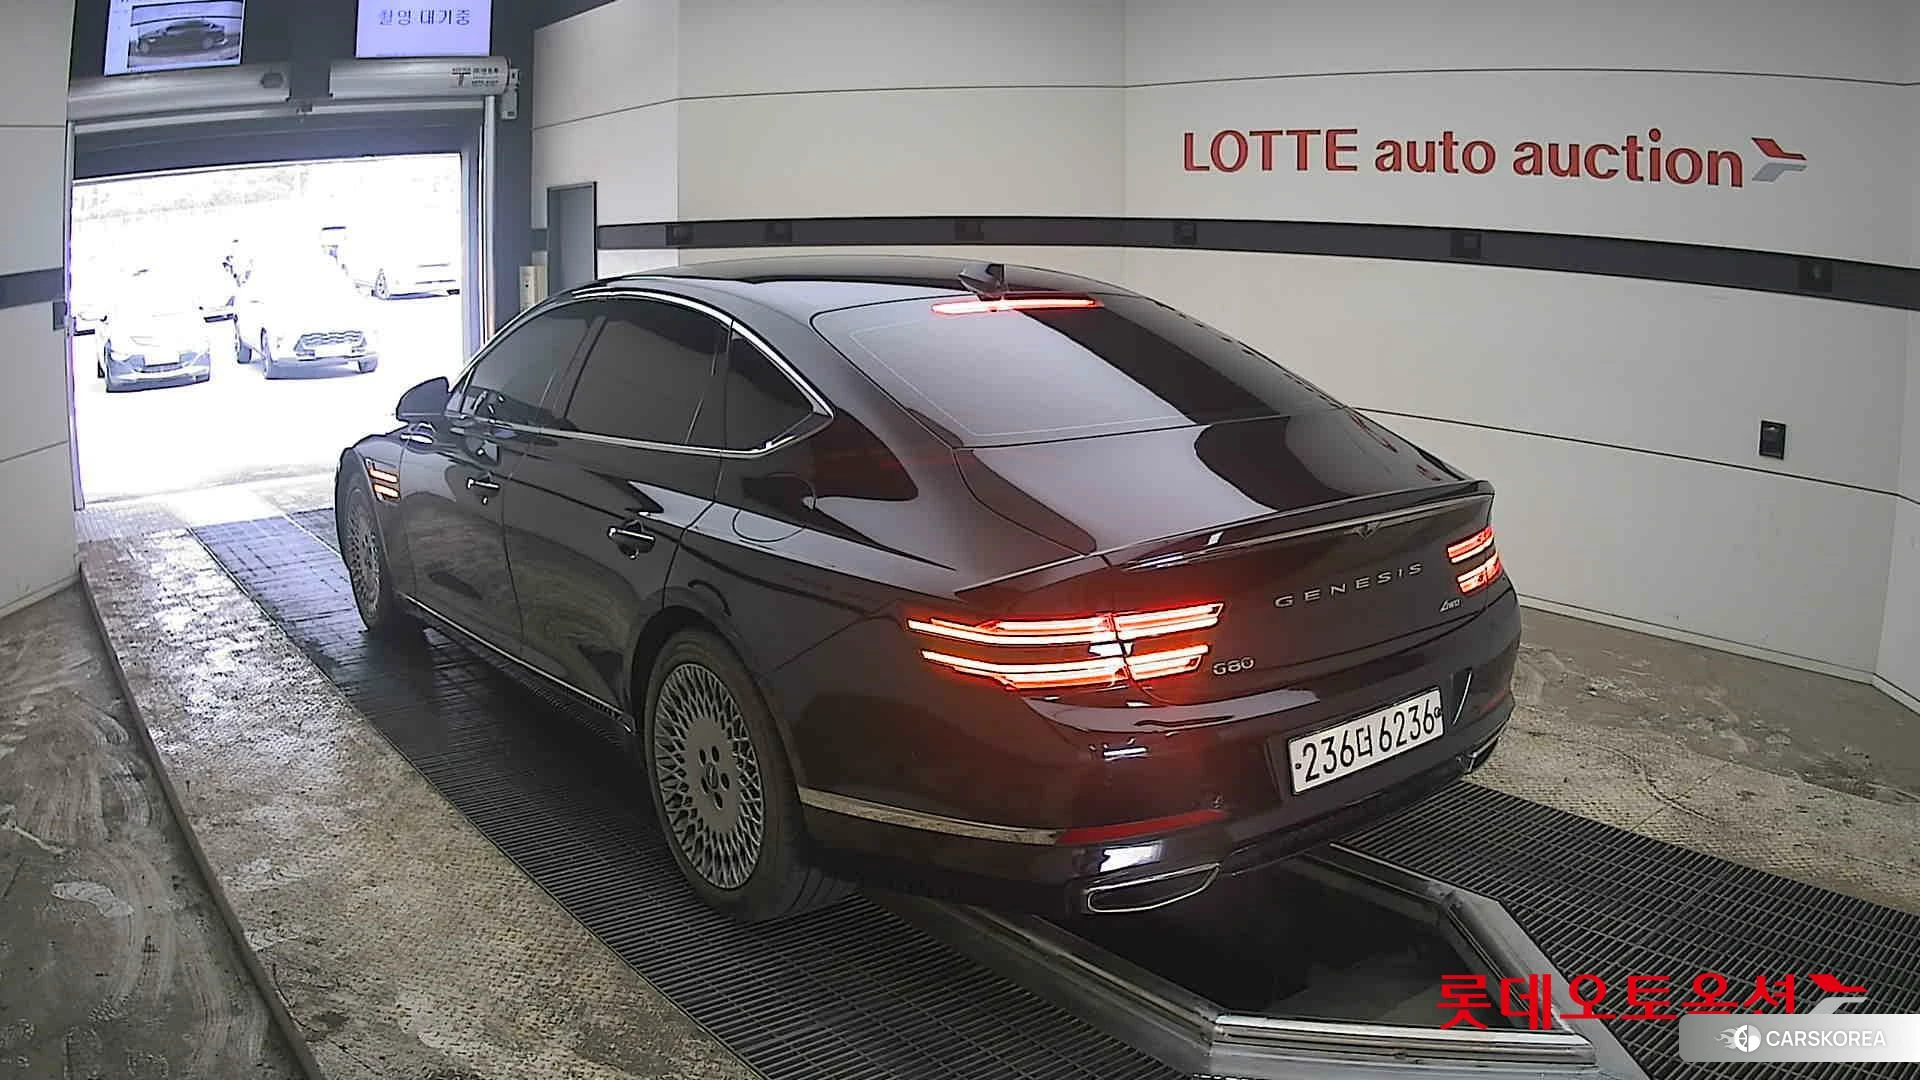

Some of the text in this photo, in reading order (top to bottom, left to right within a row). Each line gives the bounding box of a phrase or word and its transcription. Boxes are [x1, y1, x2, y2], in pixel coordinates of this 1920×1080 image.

[420, 9, 471, 26] 대기중
[1184, 128, 1744, 188] LOTTE auto auction
[1273, 563, 1423, 608] GENESIS
[1212, 656, 1255, 676] G80
